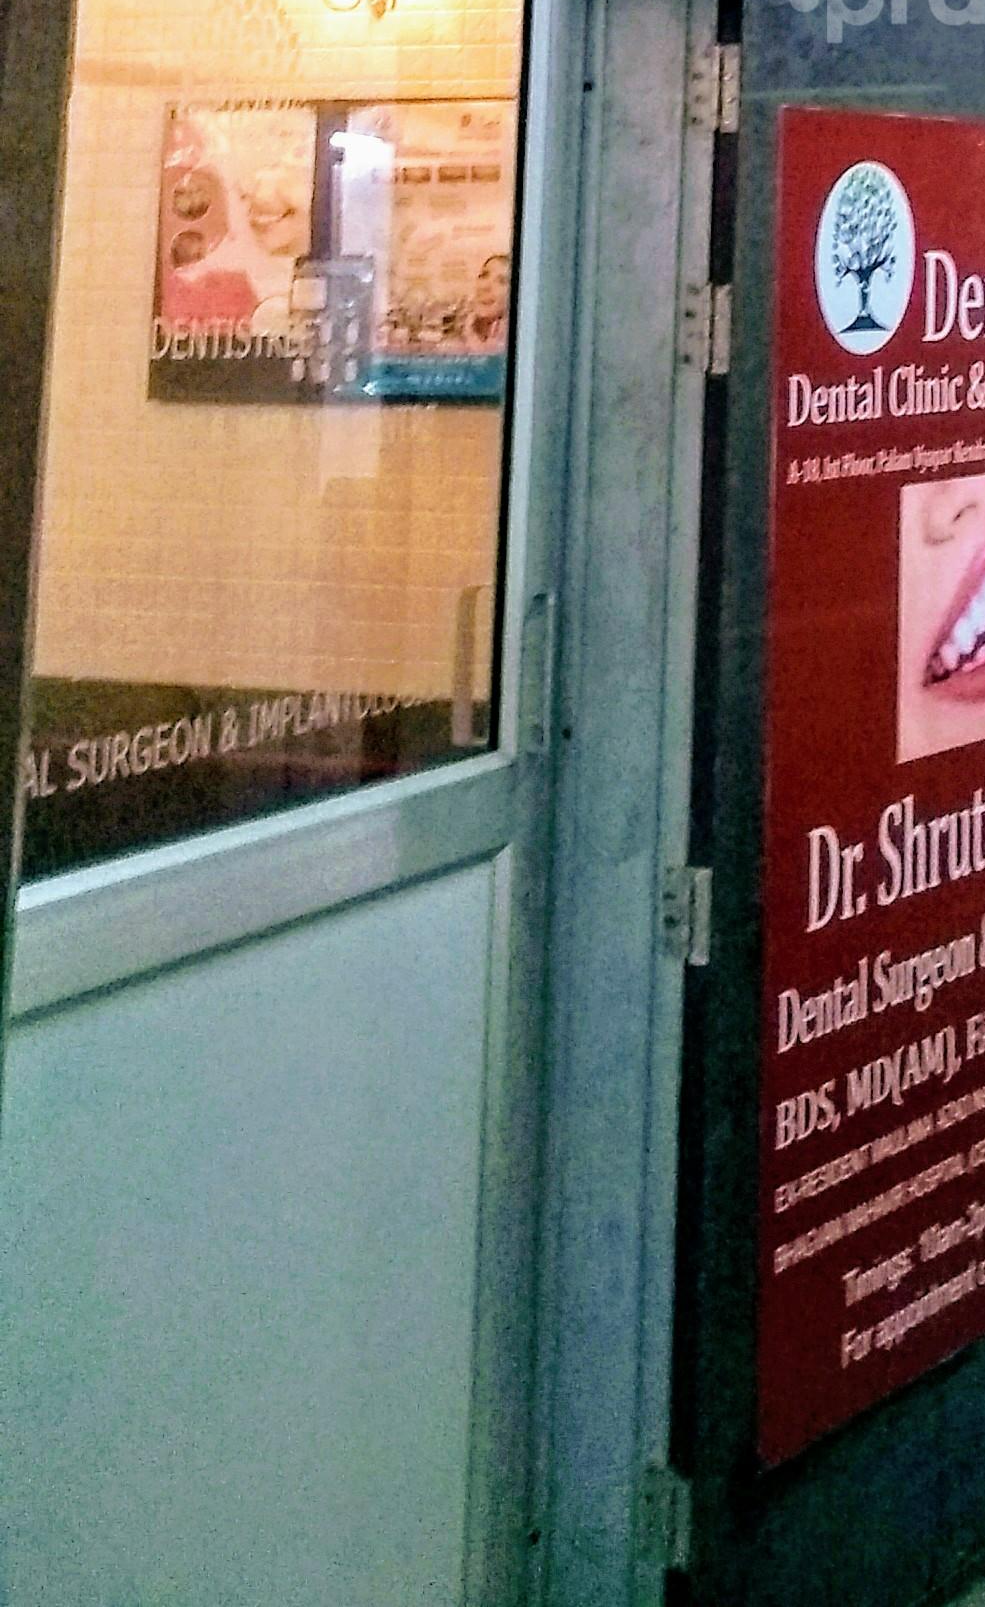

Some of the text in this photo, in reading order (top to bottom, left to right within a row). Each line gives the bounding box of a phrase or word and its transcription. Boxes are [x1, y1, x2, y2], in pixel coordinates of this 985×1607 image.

[787, 364, 882, 428] Dental
[888, 363, 962, 418] Clinic
[66, 712, 214, 792] SURGEON
[806, 822, 868, 934] Dr.
[777, 957, 868, 1056] Dental
[872, 933, 976, 1014] Surgeon
[775, 1080, 841, 1152] BDS,
